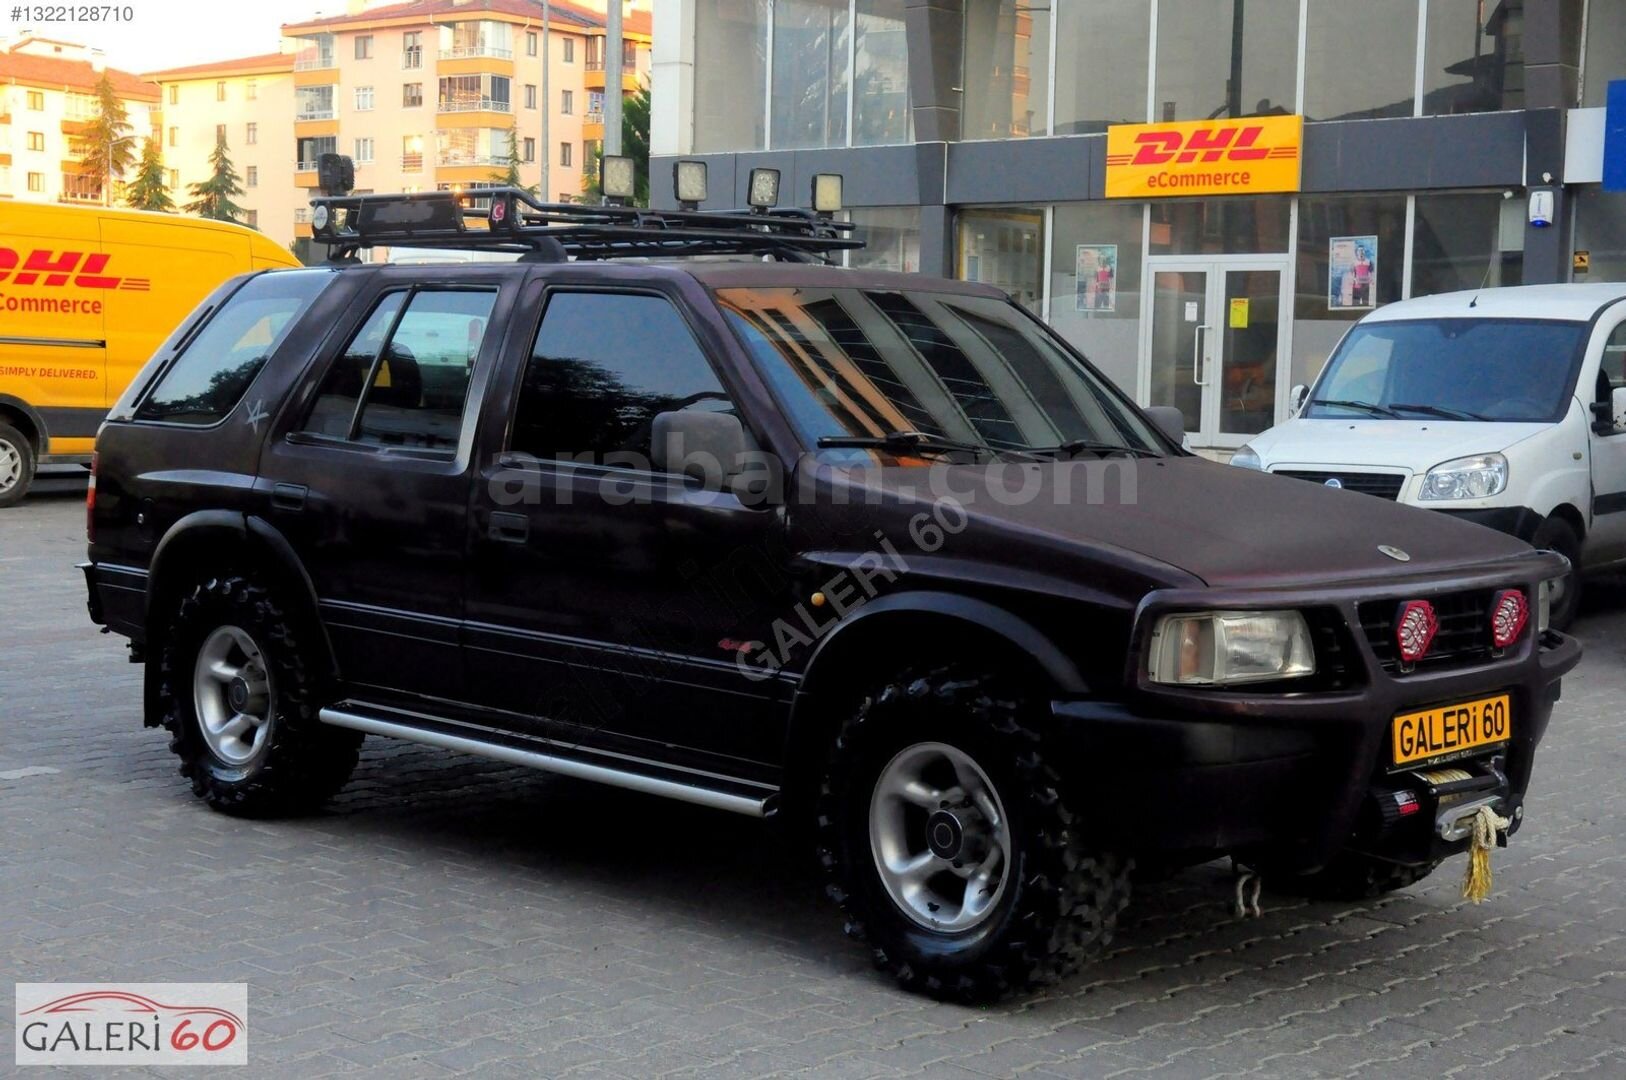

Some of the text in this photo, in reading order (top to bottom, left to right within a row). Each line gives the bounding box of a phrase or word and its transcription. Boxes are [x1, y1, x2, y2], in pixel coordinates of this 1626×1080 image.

[1131, 127, 1271, 165] DHL
[1147, 171, 1250, 188] eCommerce
[39, 367, 98, 380] DELIVERED.
[1483, 701, 1505, 739] 60
